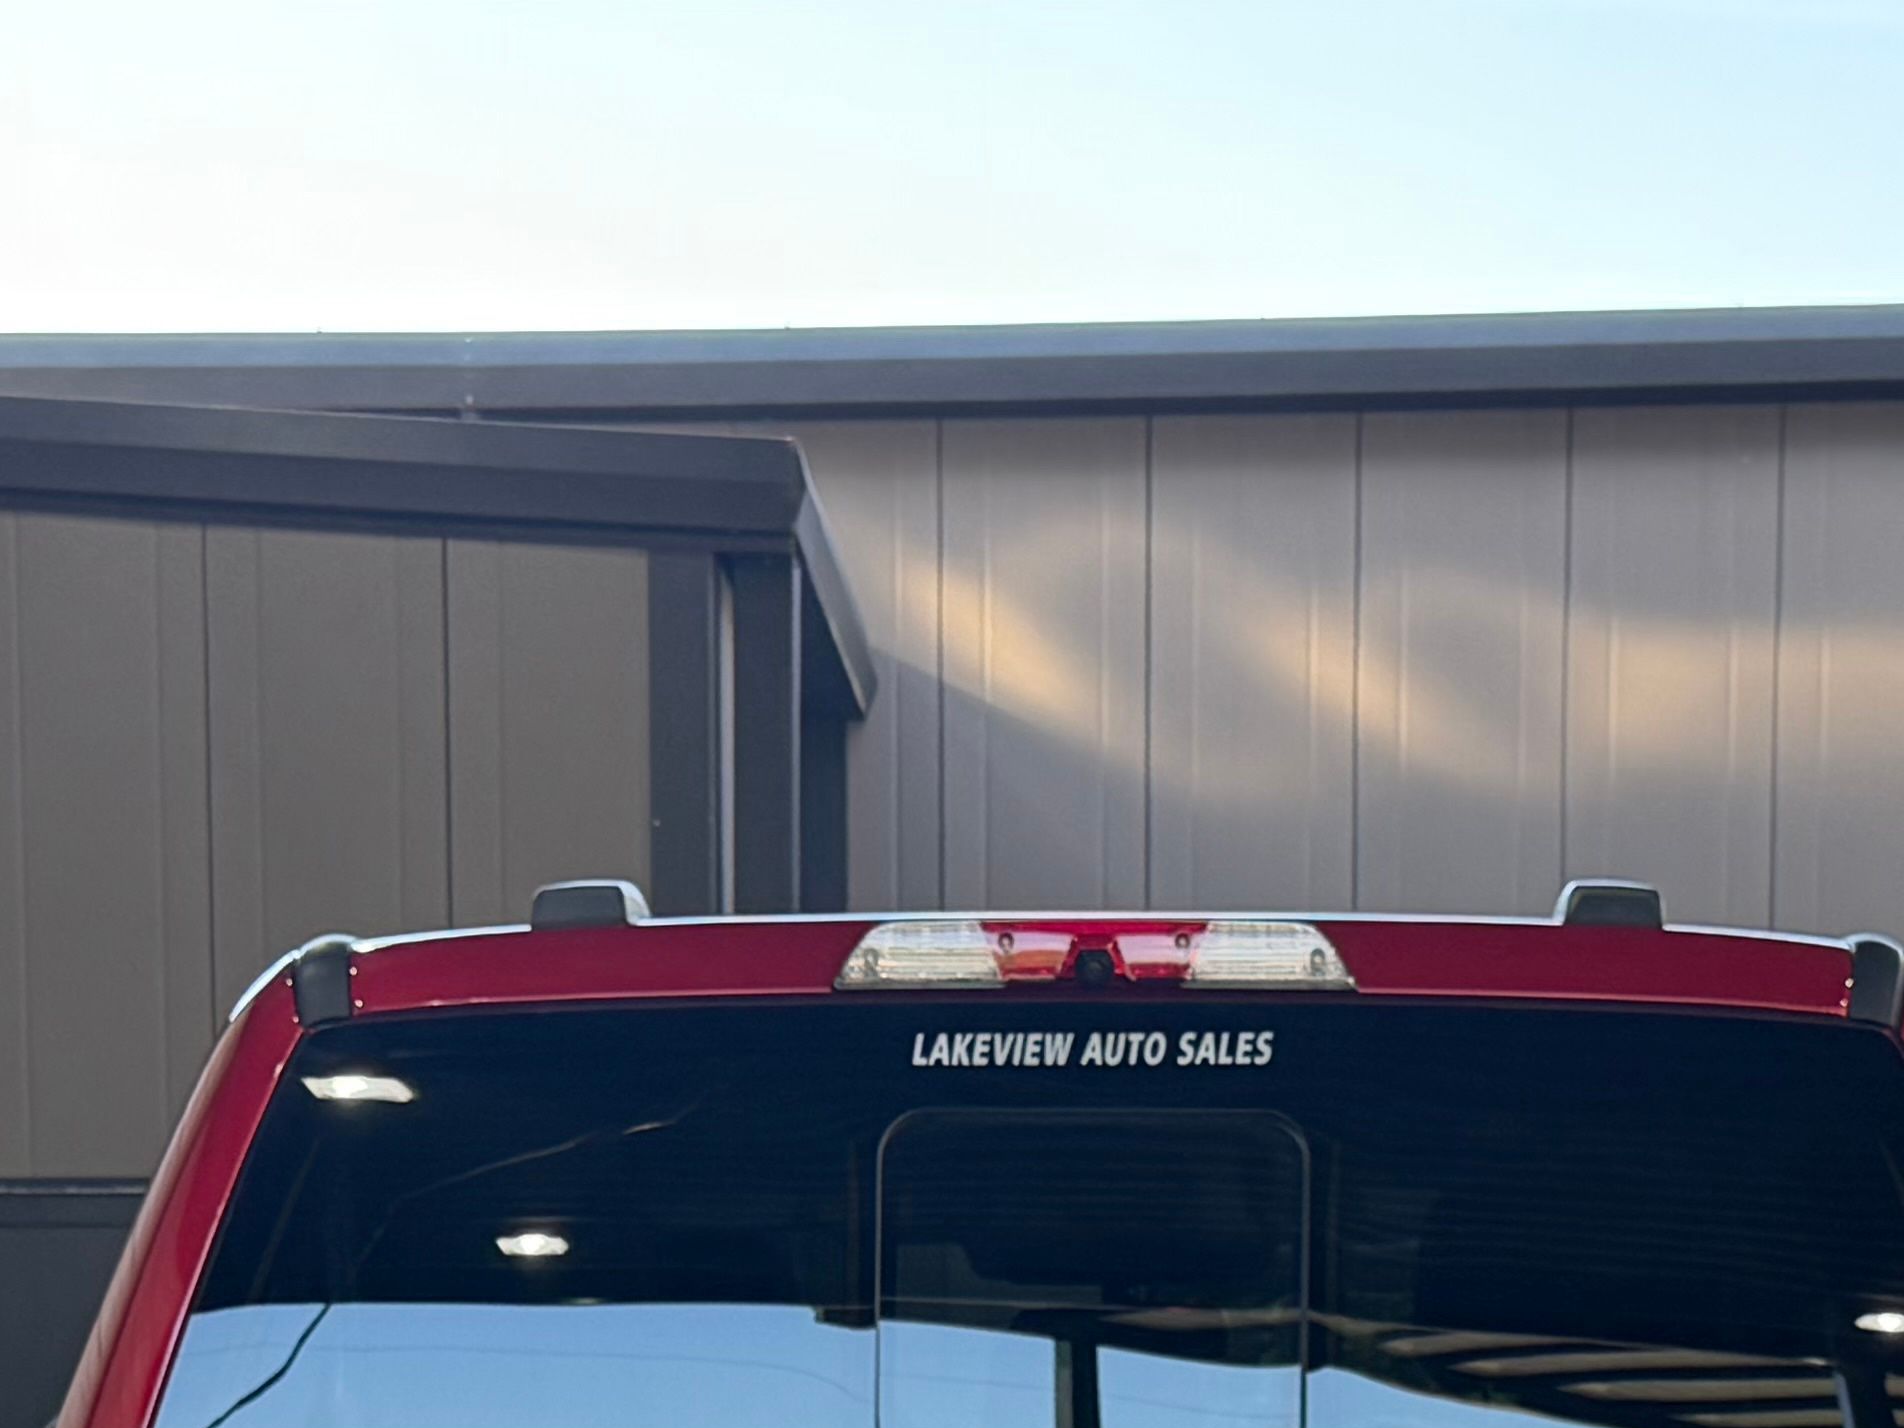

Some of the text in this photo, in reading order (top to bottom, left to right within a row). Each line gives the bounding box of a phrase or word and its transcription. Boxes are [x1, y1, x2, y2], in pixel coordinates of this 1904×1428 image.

[911, 1031, 1275, 1067] LAKEVIEW AUTO SALES
